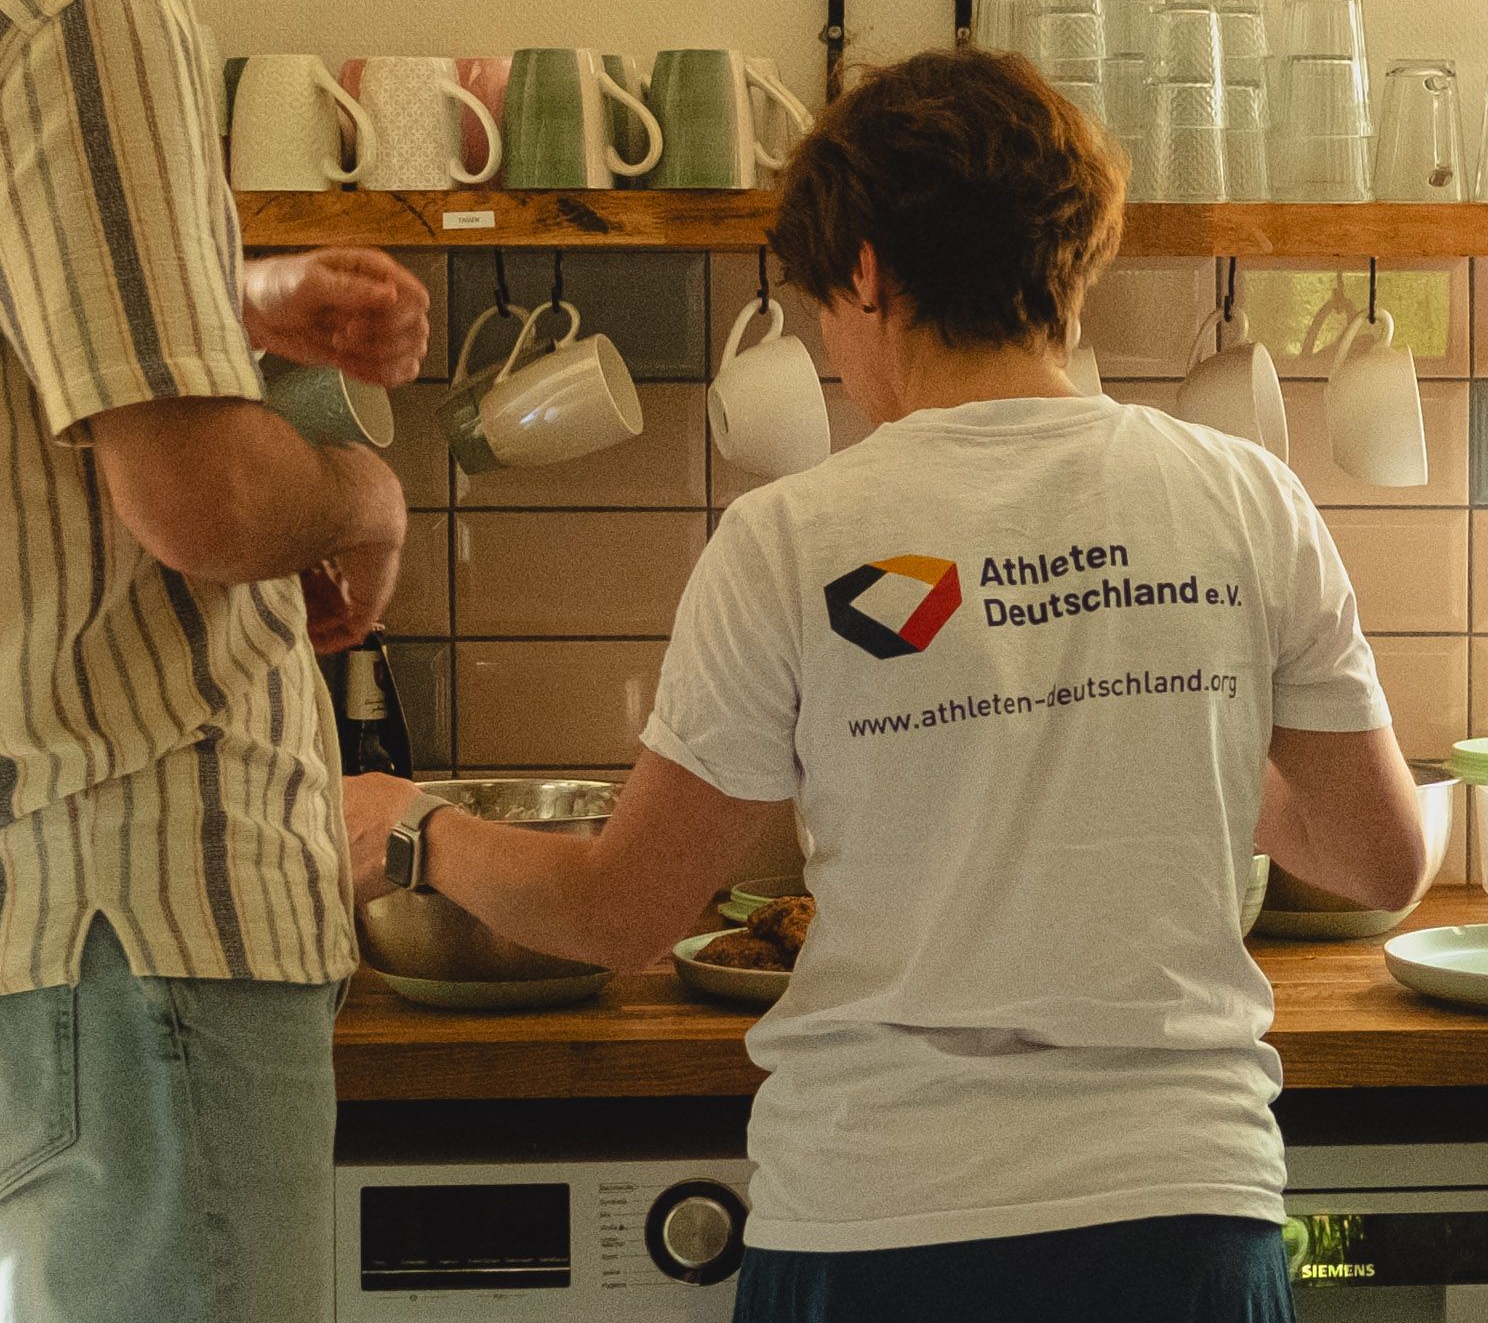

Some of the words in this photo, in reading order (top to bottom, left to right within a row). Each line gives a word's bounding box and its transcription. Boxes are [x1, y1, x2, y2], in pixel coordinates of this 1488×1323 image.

[980, 544, 1129, 587] Athleten
[983, 575, 1199, 627] Deutschland
[1205, 584, 1243, 607] e.V.
[848, 669, 1237, 737] www.athleten-deutschland.org
[1301, 1263, 1376, 1279] SIEMENS
